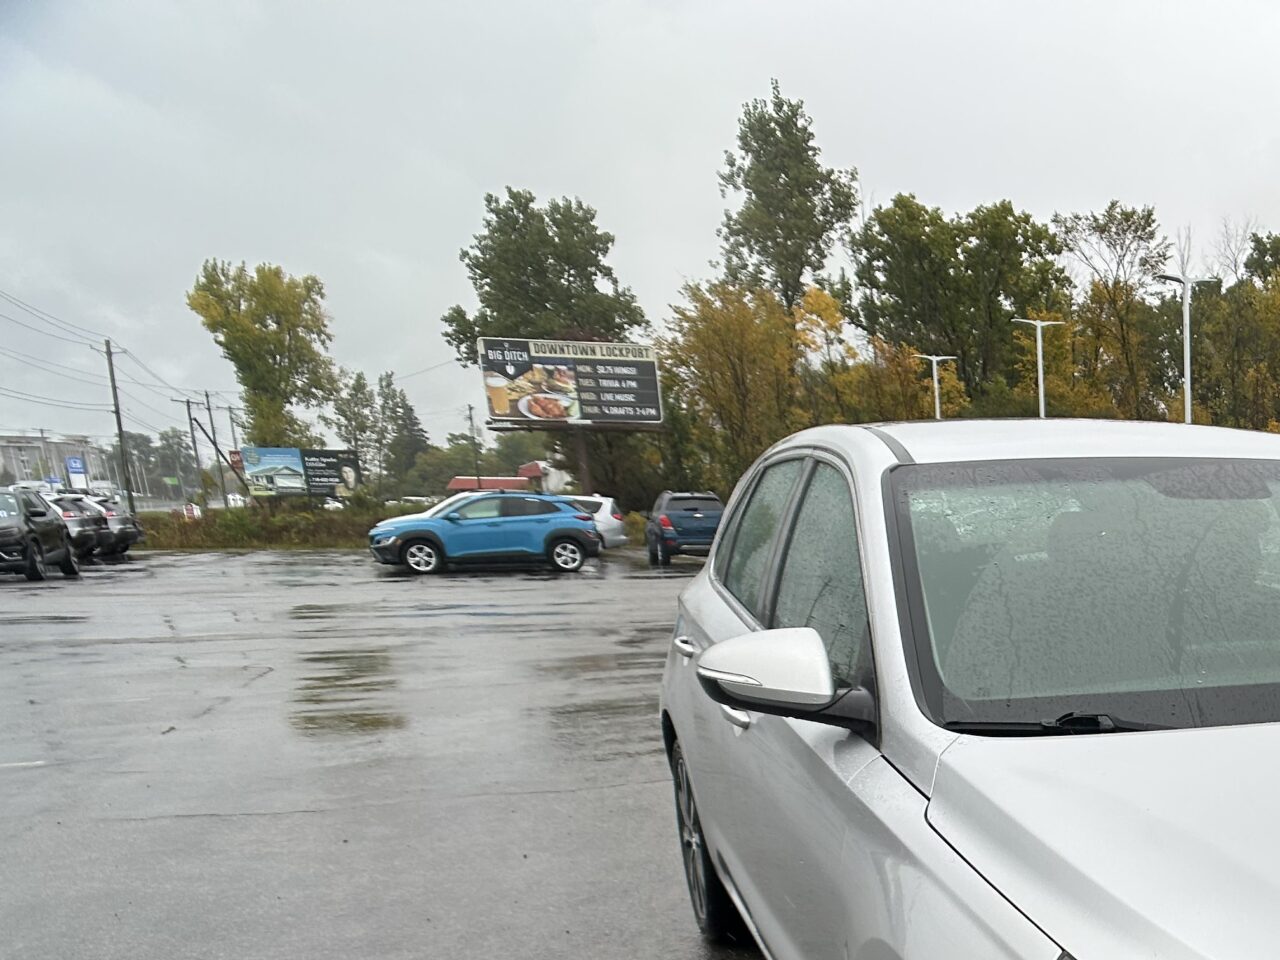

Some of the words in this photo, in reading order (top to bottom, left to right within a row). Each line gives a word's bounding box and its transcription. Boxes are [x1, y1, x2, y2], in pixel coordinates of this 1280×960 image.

[488, 349, 503, 360] BIG
[504, 350, 529, 361] DITCH
[533, 342, 597, 357] DOWNTOWN
[600, 346, 650, 359] LOCKPORT
